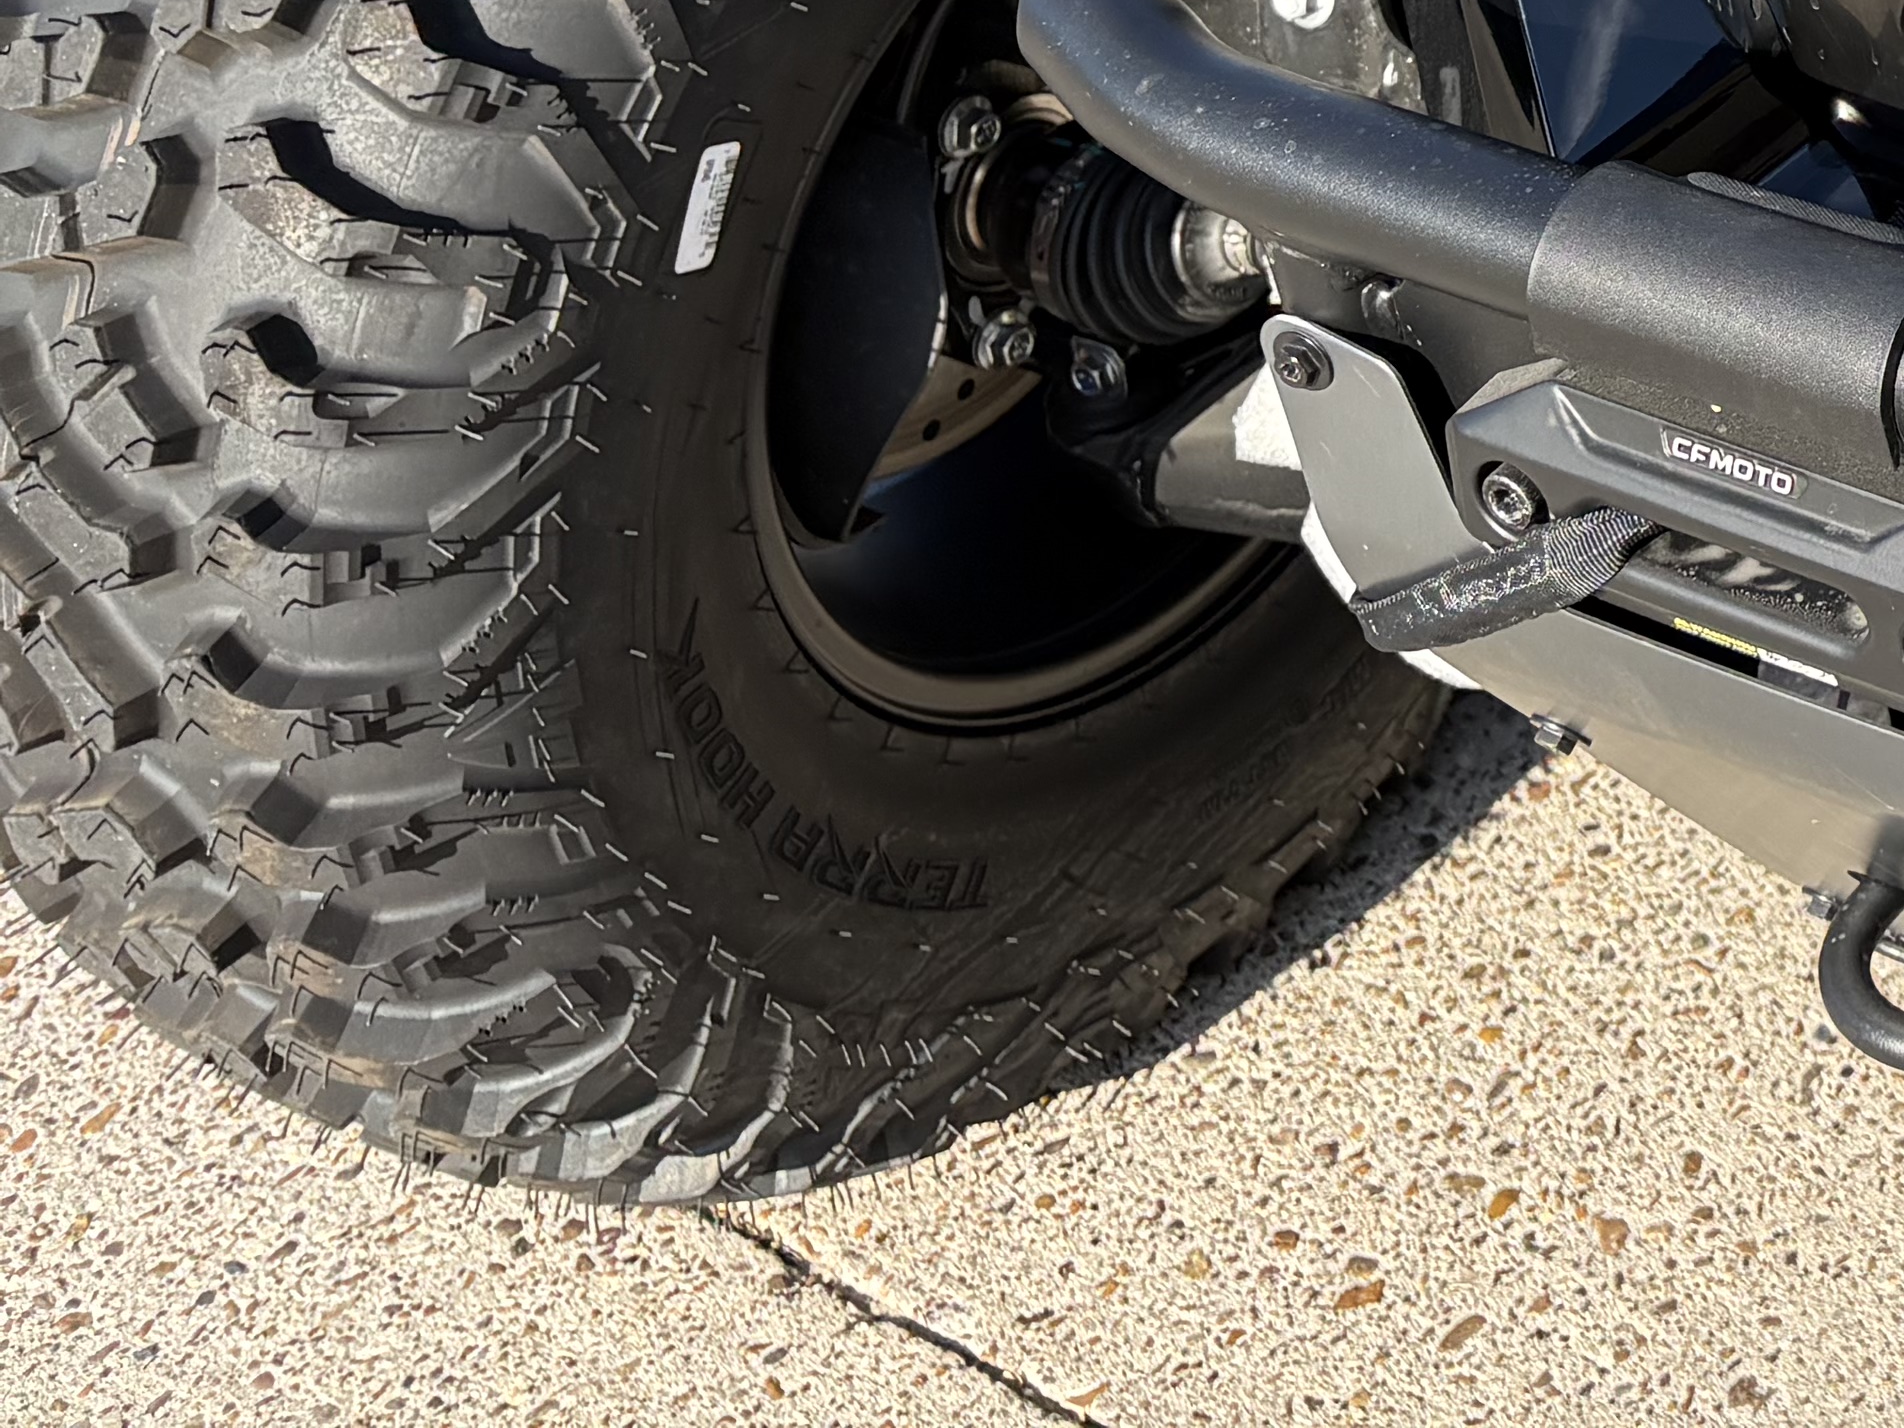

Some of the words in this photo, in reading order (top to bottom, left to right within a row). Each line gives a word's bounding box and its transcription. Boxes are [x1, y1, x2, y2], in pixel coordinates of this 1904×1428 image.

[1671, 436, 1793, 496] CFMOTO
[655, 596, 777, 830] HOOK
[771, 804, 989, 912] TERRA
